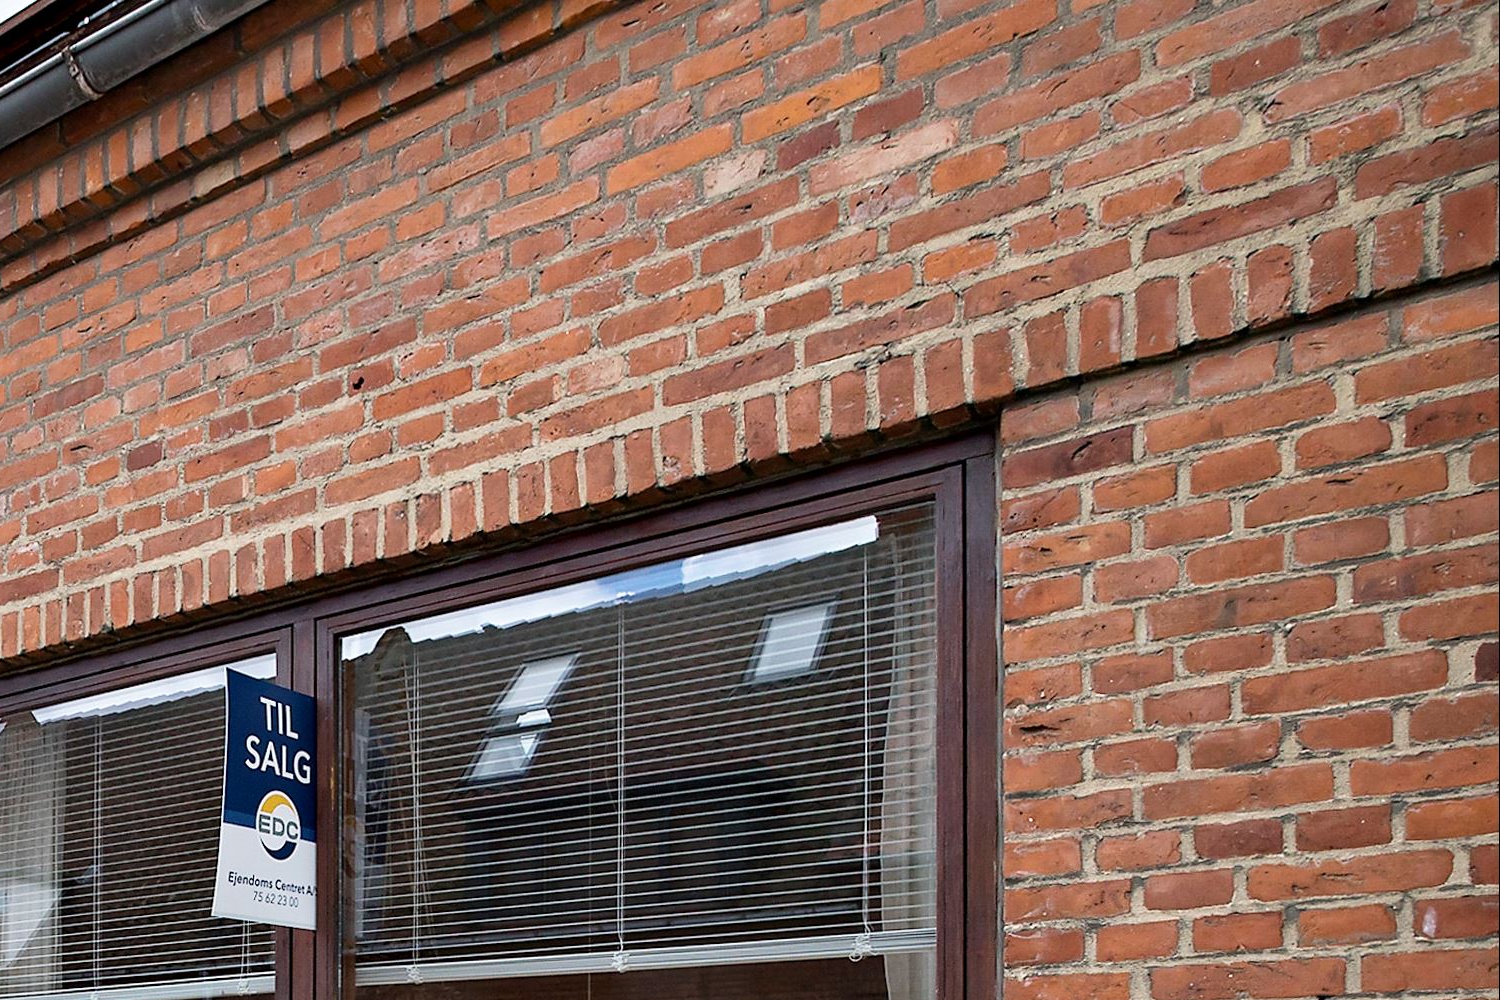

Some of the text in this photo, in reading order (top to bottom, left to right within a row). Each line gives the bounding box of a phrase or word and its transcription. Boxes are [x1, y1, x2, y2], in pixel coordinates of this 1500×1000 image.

[260, 696, 299, 740] TIL
[245, 735, 311, 785] SALG
[258, 814, 299, 840] EDC
[228, 871, 273, 889] Ejendoms
[275, 879, 305, 895] Centret
[253, 890, 299, 908] 75 62 23 00
